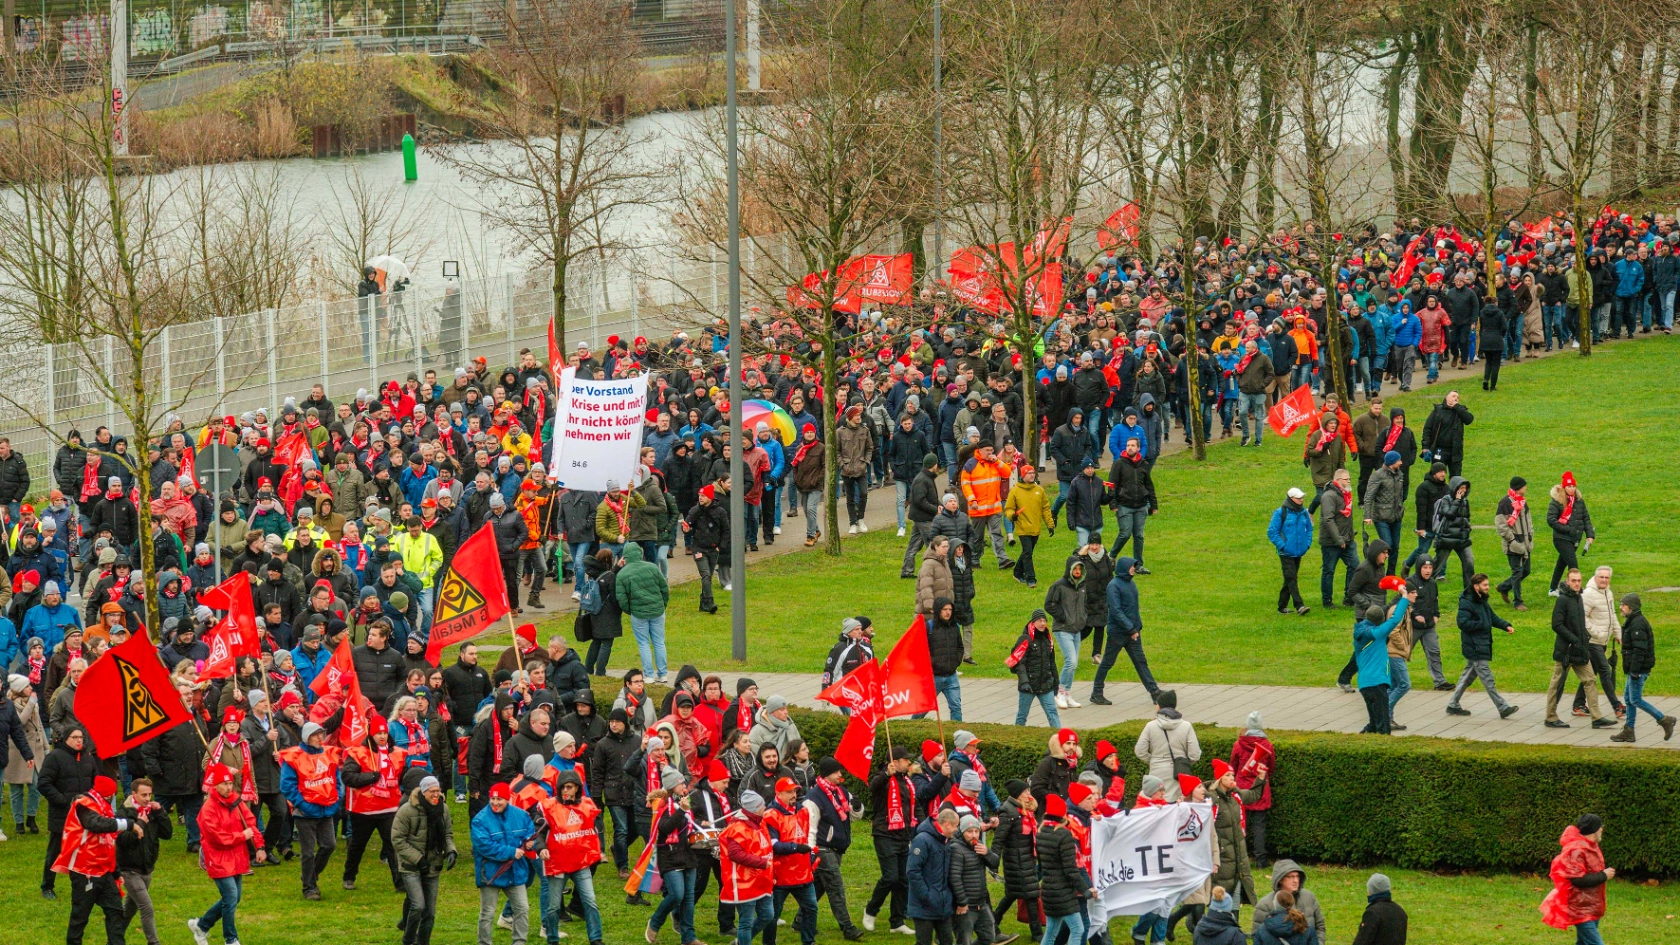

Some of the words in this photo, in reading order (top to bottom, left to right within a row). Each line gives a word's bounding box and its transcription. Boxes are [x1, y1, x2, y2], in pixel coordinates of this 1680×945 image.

[586, 384, 634, 396] Vorstand
[571, 398, 600, 411] Krise
[603, 400, 625, 411] und
[627, 397, 641, 408] mit
[566, 413, 579, 425] hr
[581, 416, 612, 427] nicht
[565, 429, 611, 441] nehmen
[613, 430, 631, 440] wir
[1118, 859, 1134, 881] die
[1135, 844, 1174, 876] TE
